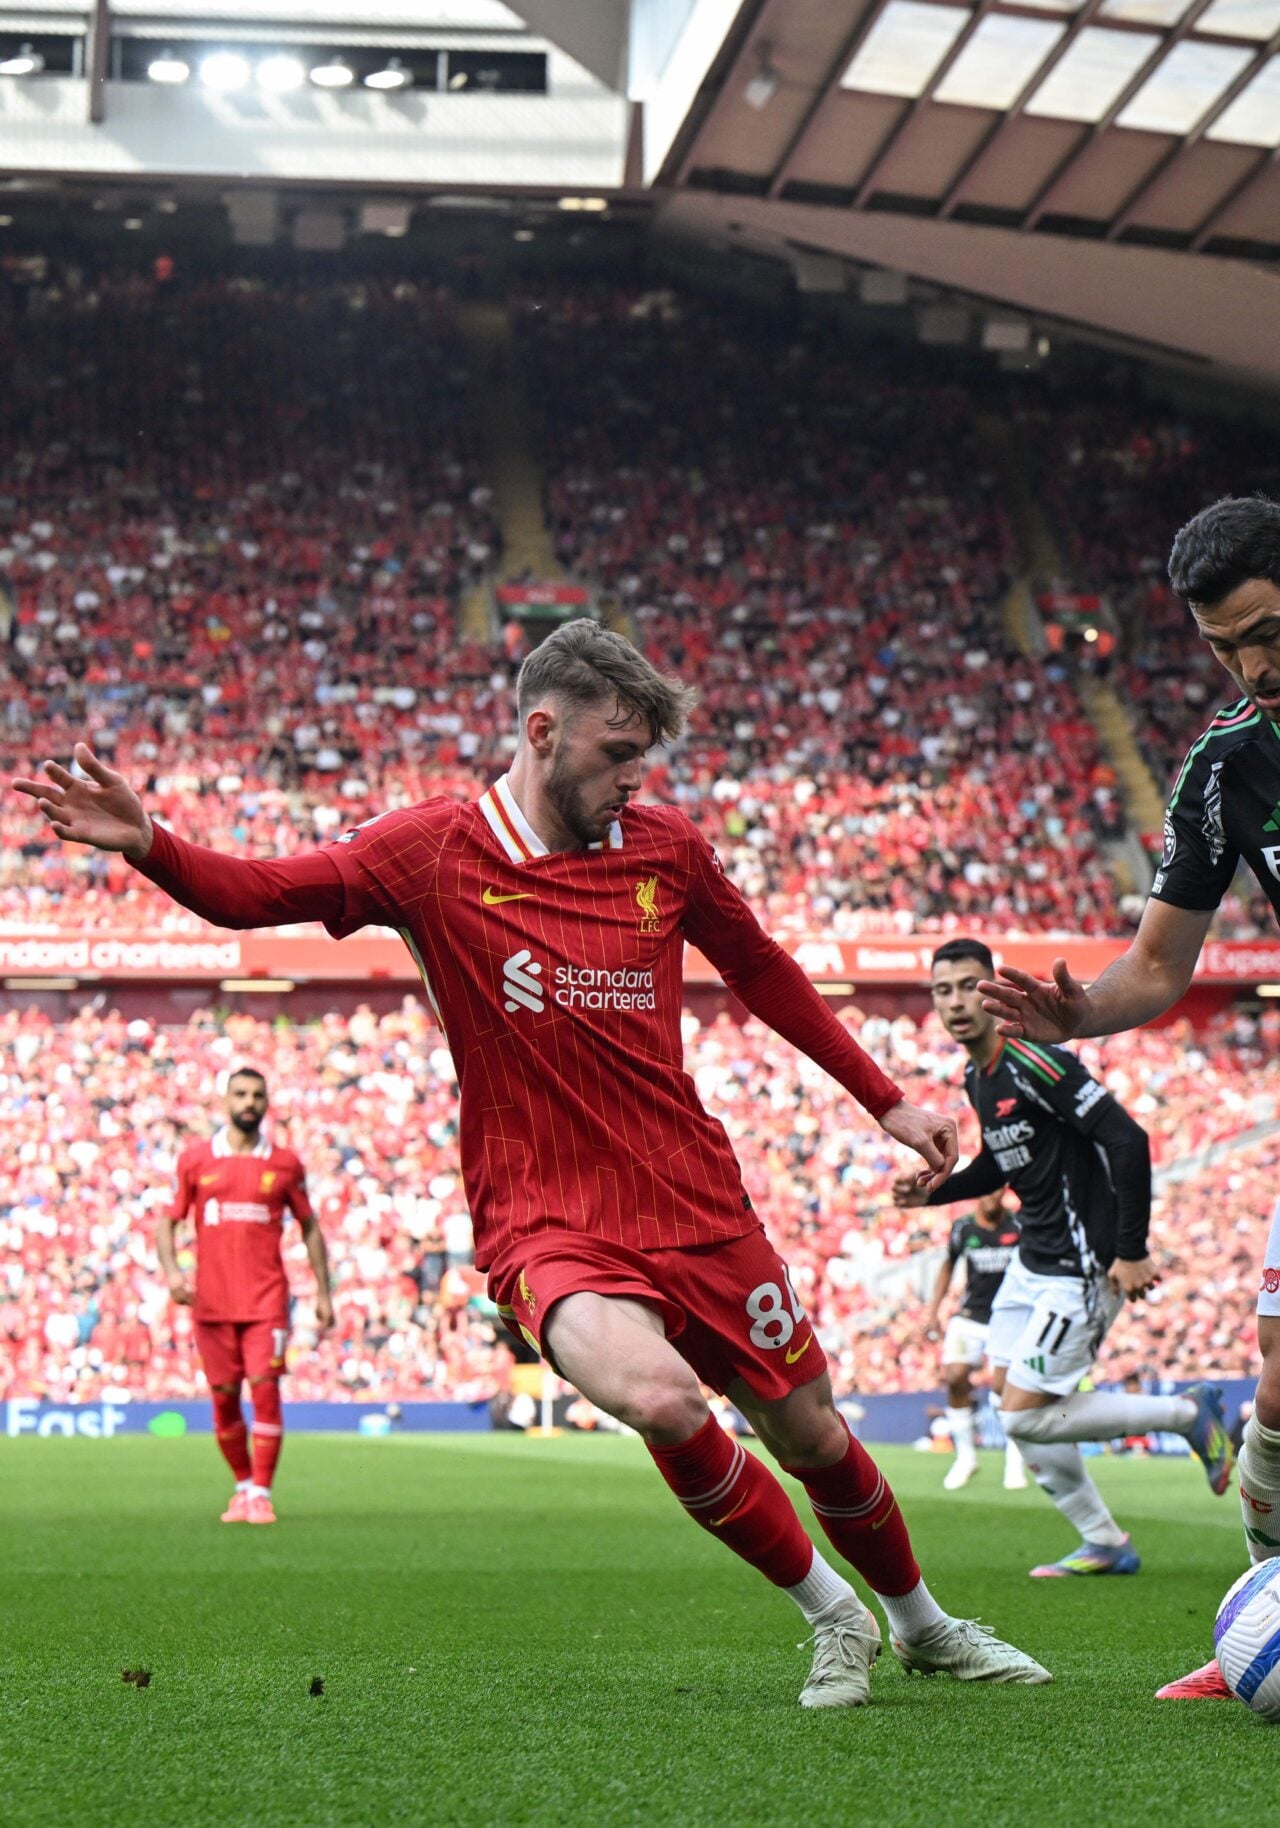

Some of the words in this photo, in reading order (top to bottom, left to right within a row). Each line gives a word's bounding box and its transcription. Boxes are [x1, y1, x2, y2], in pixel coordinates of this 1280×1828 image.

[555, 965, 653, 988] standard
[555, 987, 656, 1010] chartered
[1036, 1311, 1072, 1356] 11
[1240, 1487, 1273, 1514] FC
